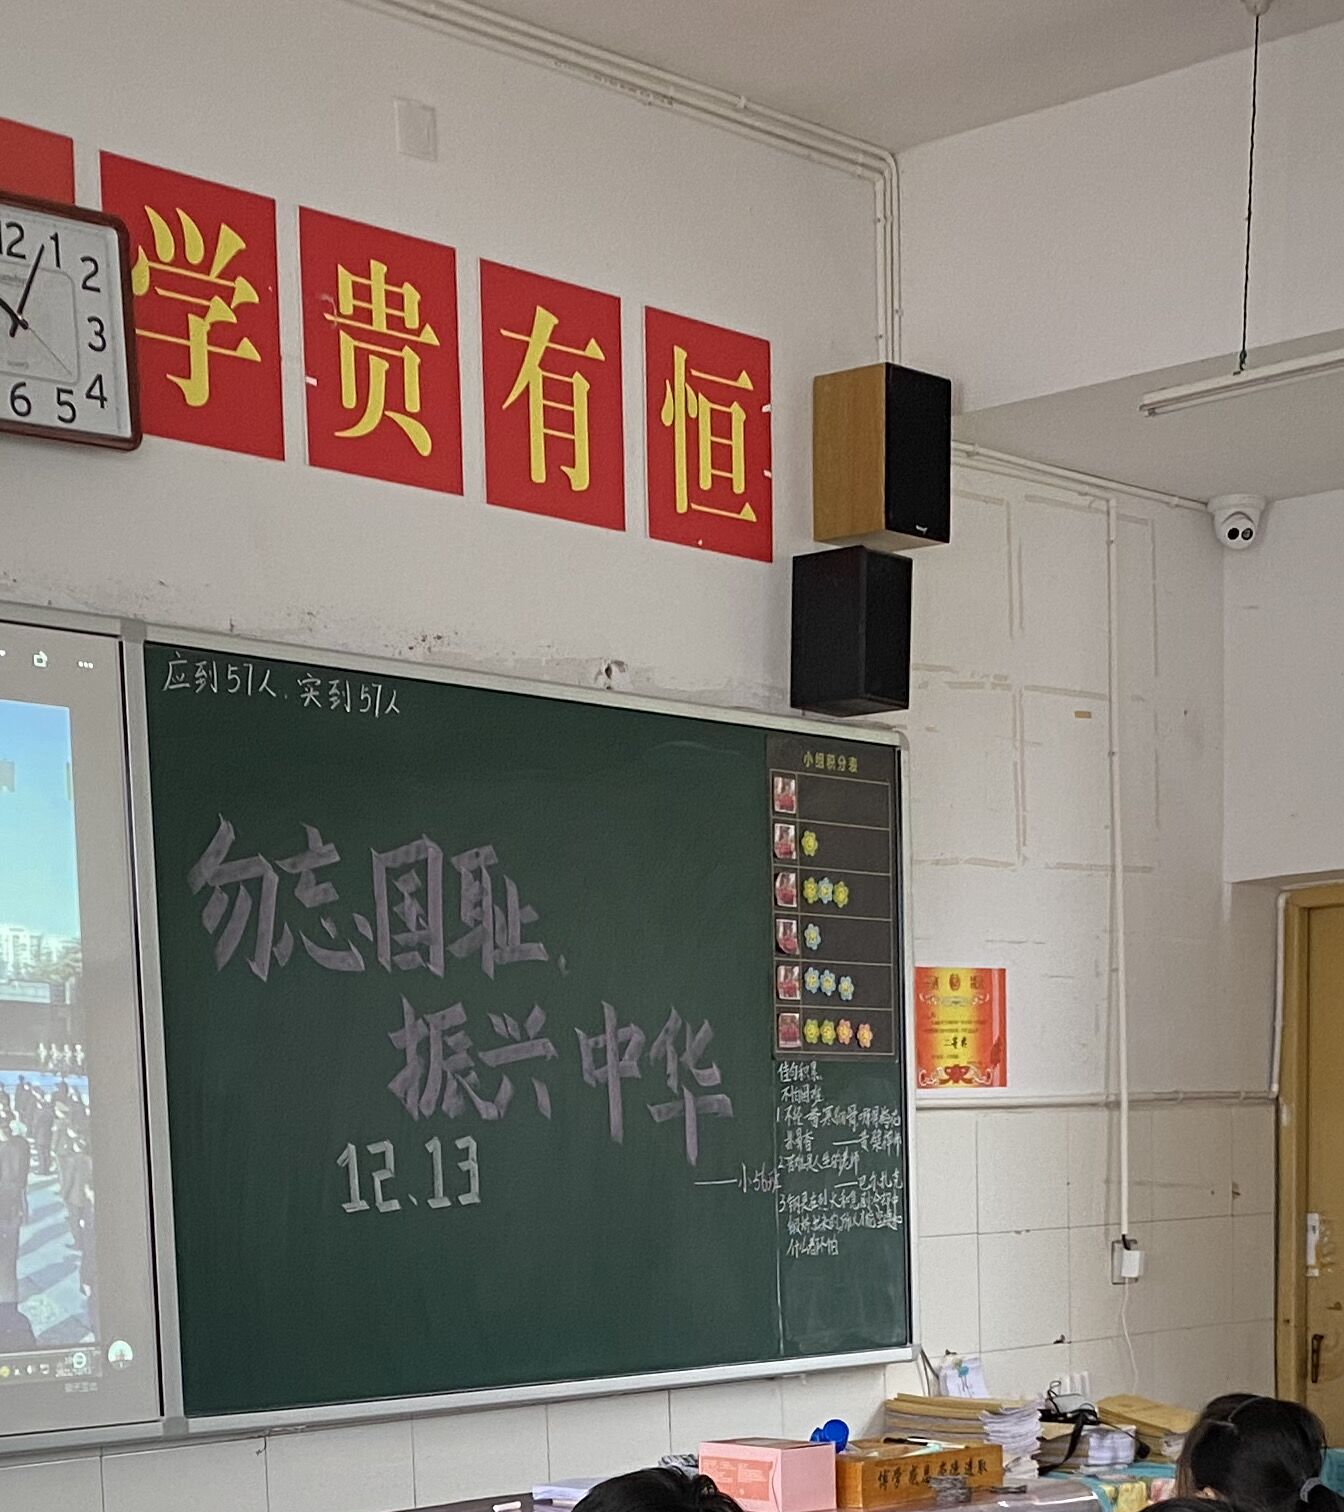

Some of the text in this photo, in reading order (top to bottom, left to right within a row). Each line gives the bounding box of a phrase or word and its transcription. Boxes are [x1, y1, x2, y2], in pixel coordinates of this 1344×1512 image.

[50, 233, 61, 268] 1
[80, 257, 100, 292] 2
[87, 316, 106, 352] 3
[131, 205, 758, 523] 学贵有恒
[10, 382, 31, 416] 6
[56, 387, 76, 423] 5
[85, 374, 108, 408] 4
[387, 993, 735, 1168] 振兴中华
